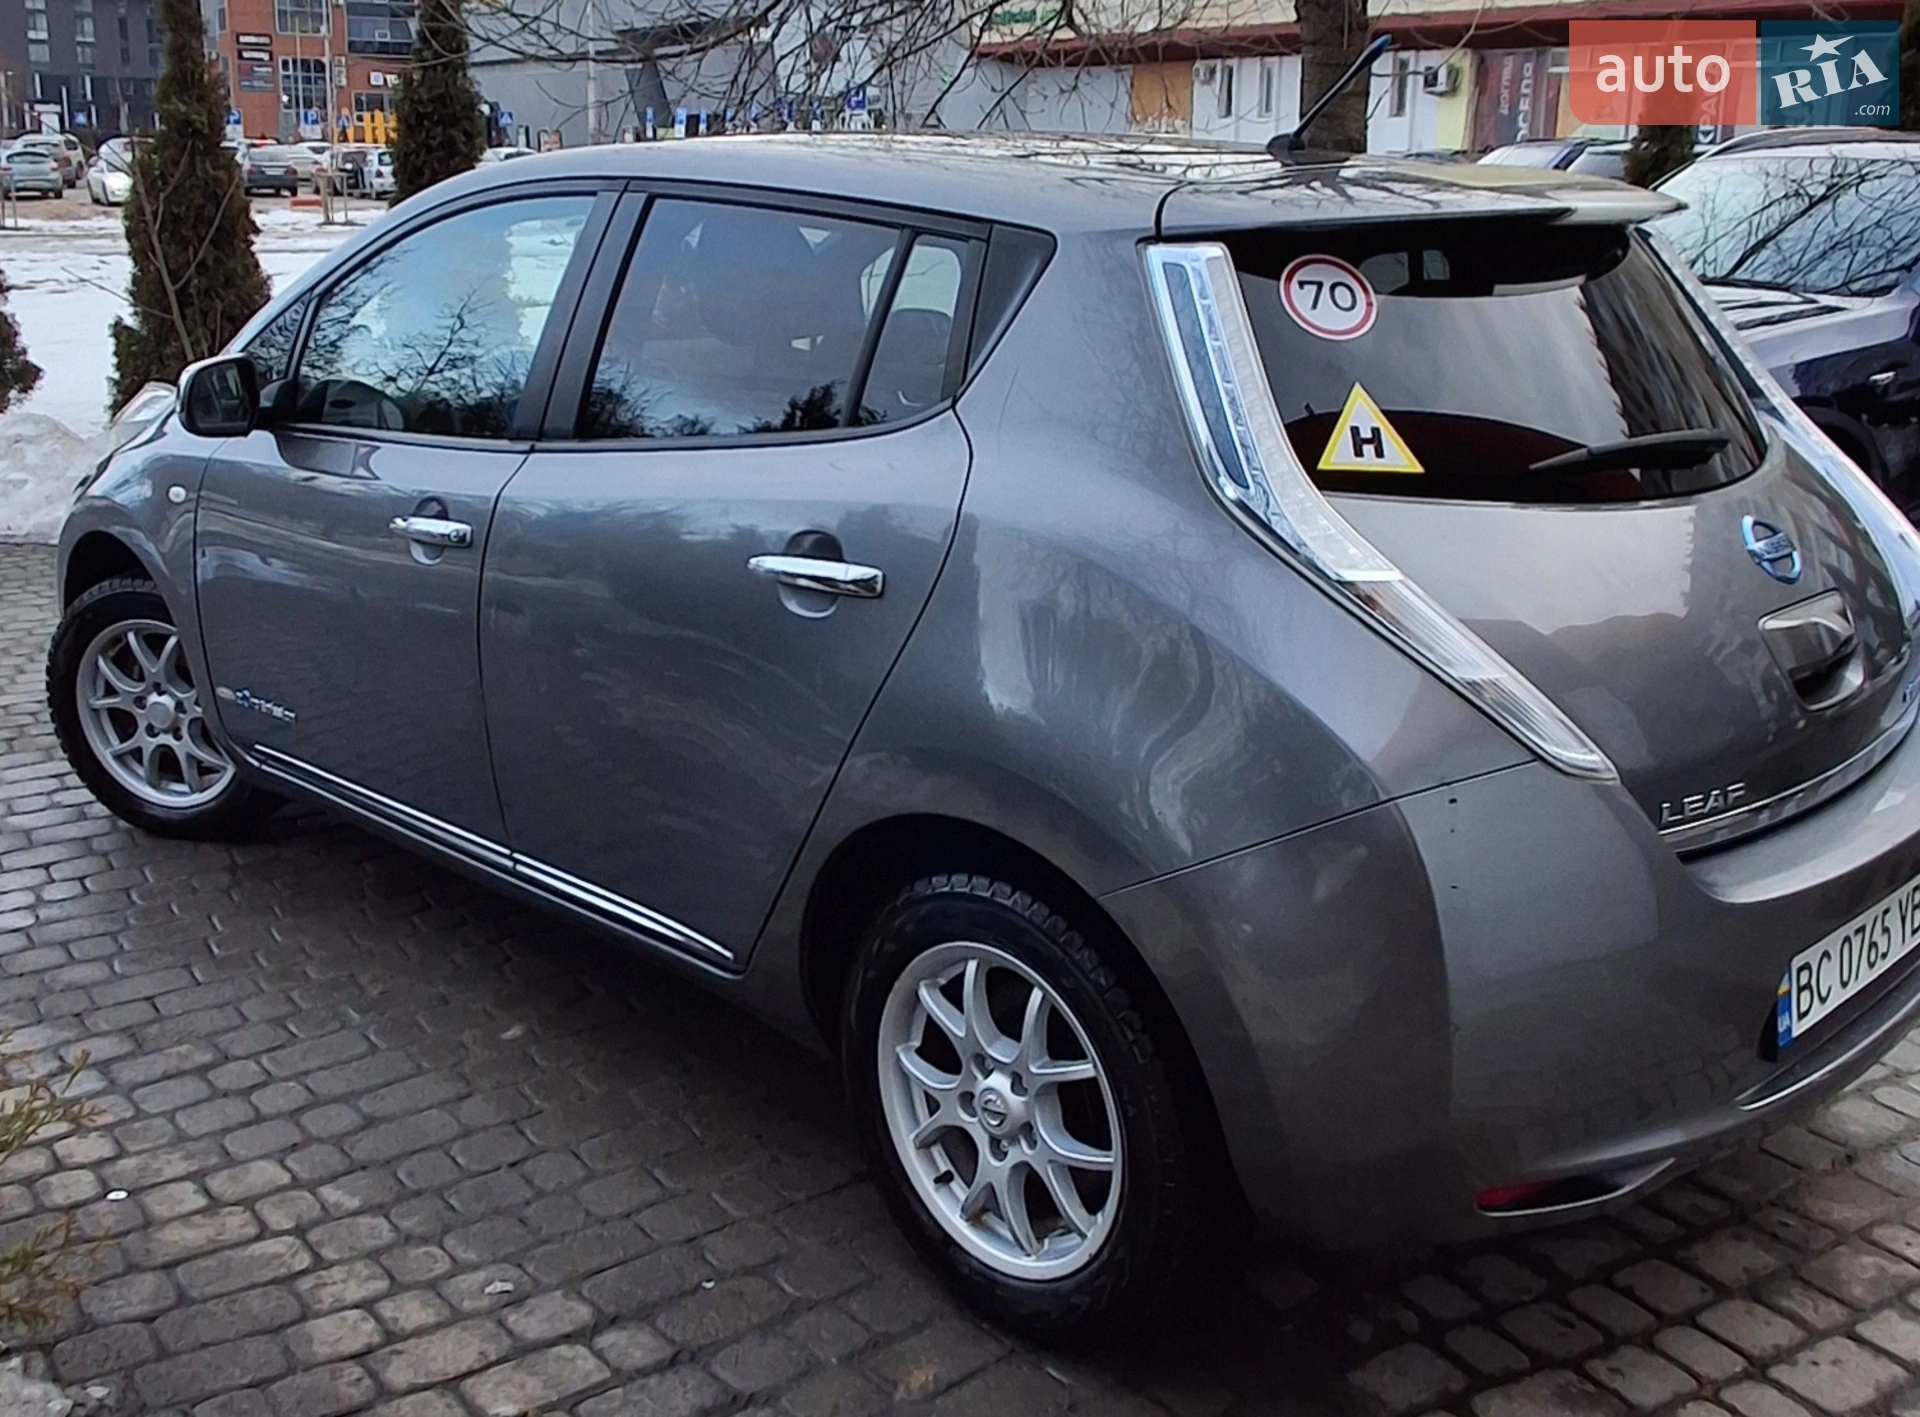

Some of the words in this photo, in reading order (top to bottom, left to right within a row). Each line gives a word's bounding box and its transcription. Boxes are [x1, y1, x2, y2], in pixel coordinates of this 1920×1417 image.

[1297, 280, 1358, 312] 70
[1660, 782, 1746, 825] LEAF
[1796, 949, 1833, 1021] BC
[1839, 906, 1892, 989] 0765
[1778, 1012, 1791, 1033] UA
